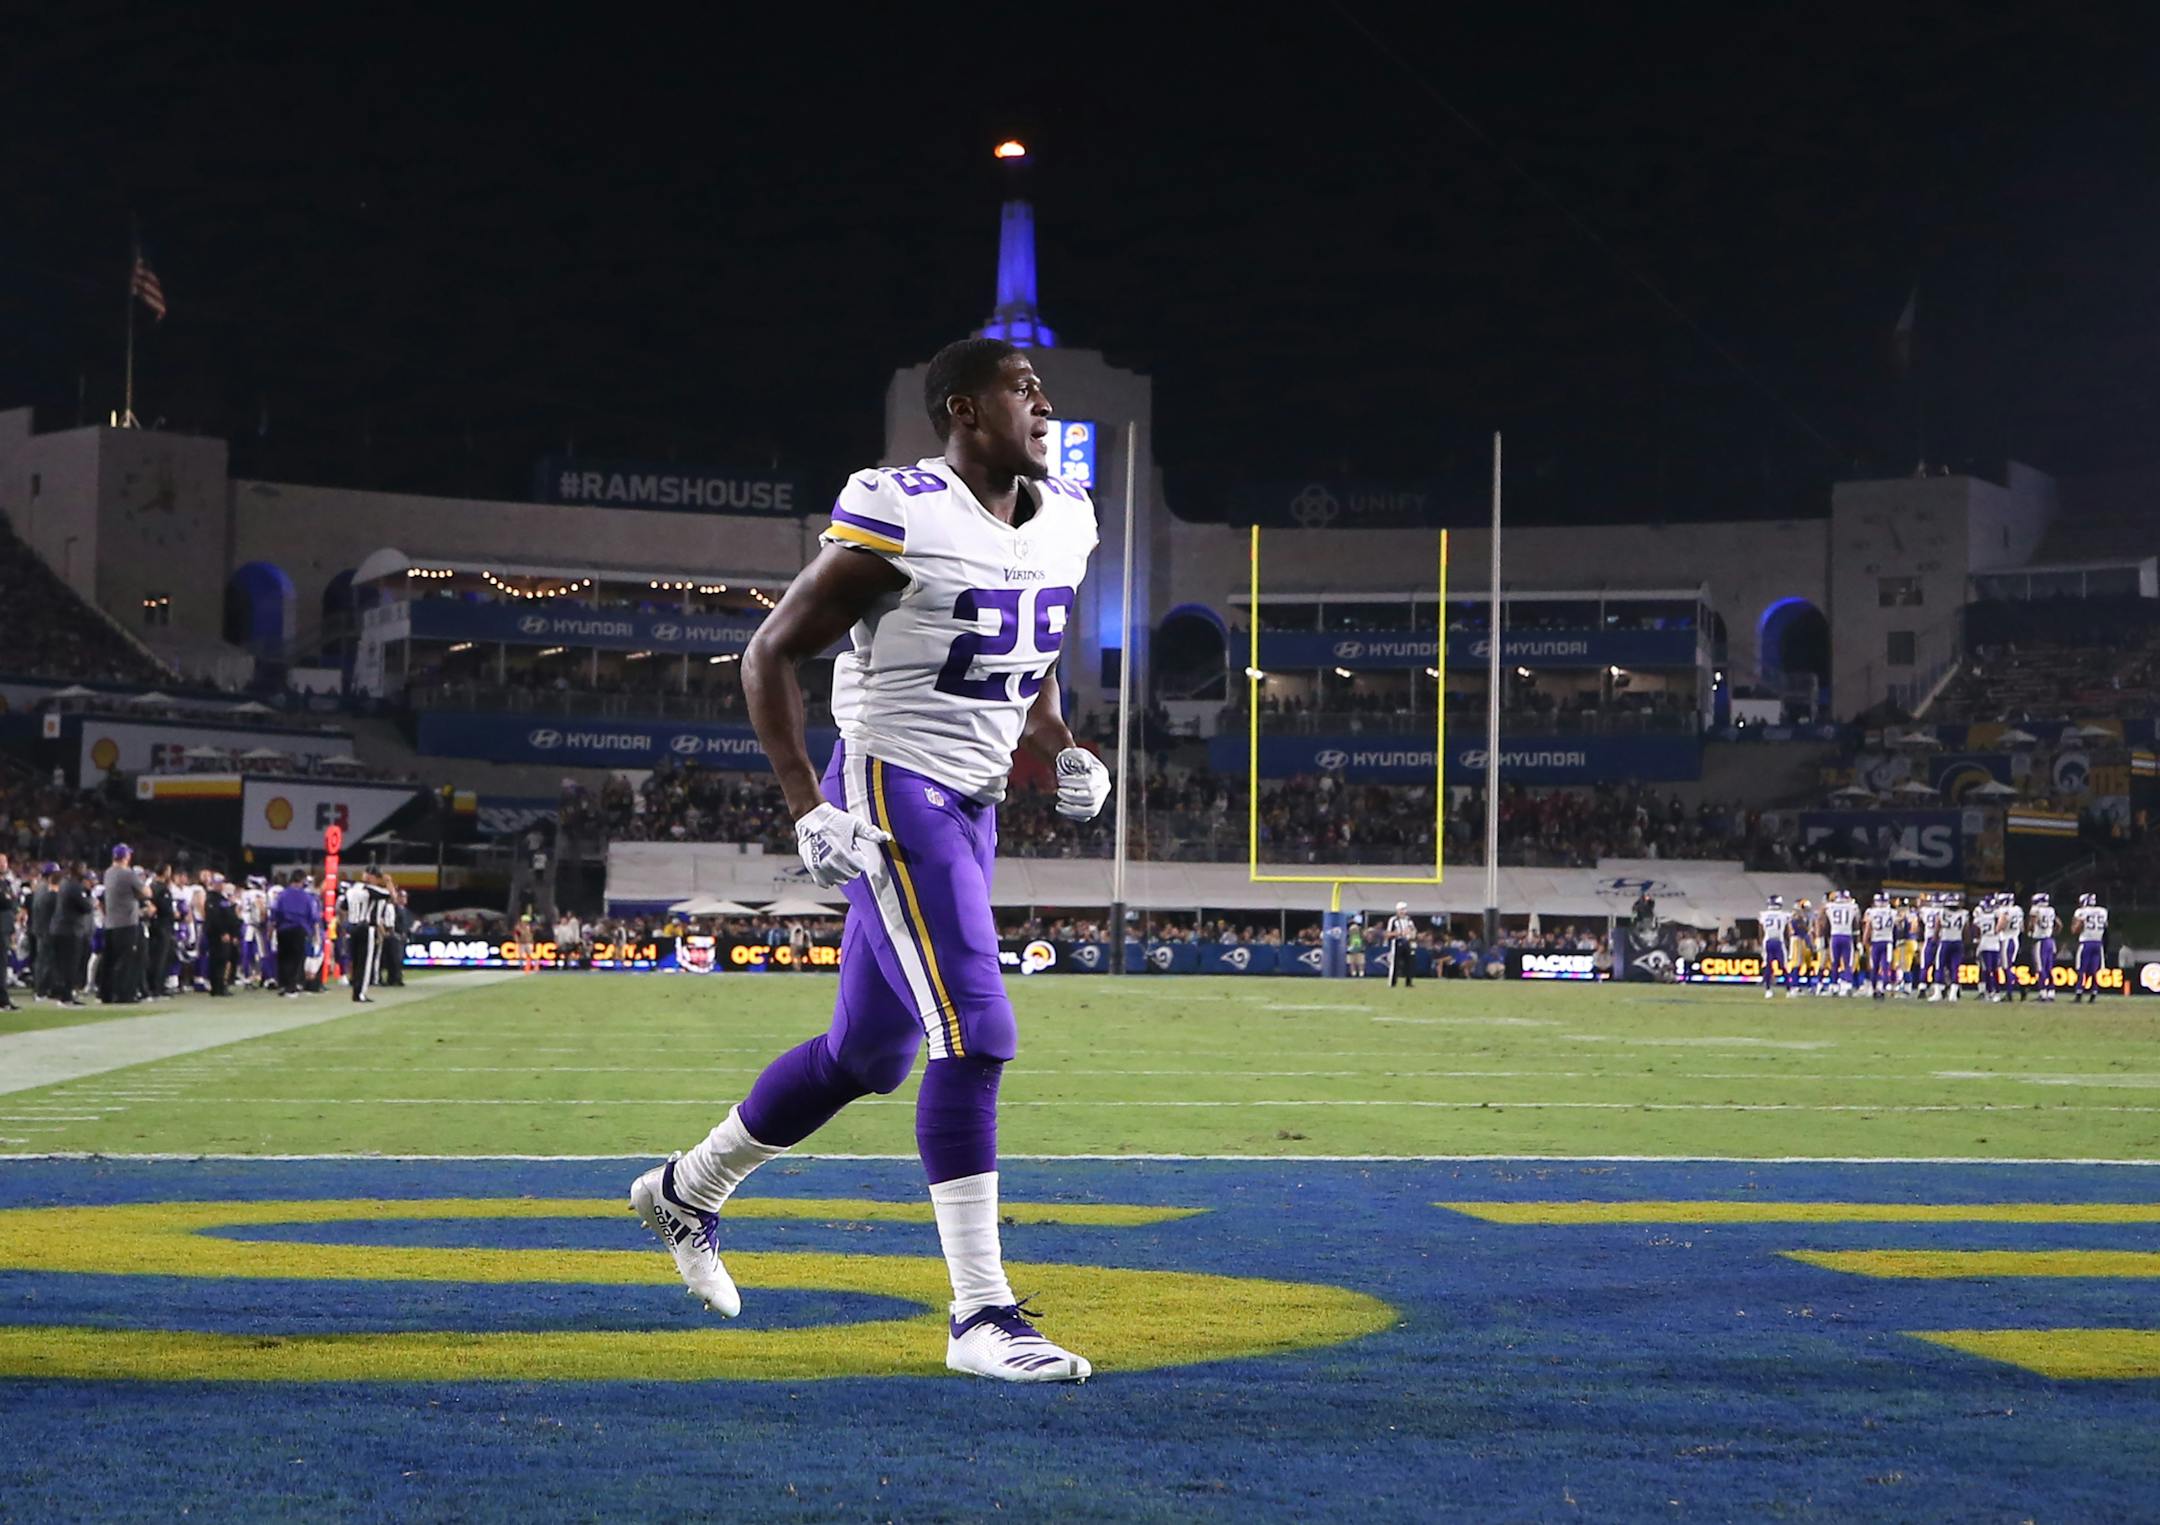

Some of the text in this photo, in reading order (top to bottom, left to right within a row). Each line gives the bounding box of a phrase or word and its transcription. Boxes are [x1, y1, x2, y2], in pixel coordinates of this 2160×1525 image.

[559, 471, 793, 511] #RAMSHOUSE
[553, 620, 633, 637] HYUNDAI
[934, 585, 1077, 701] 29
[1505, 641, 1588, 656] HYUNDAI
[566, 732, 651, 750] HYUNDAI
[1498, 751, 1585, 767] HYUNDAI
